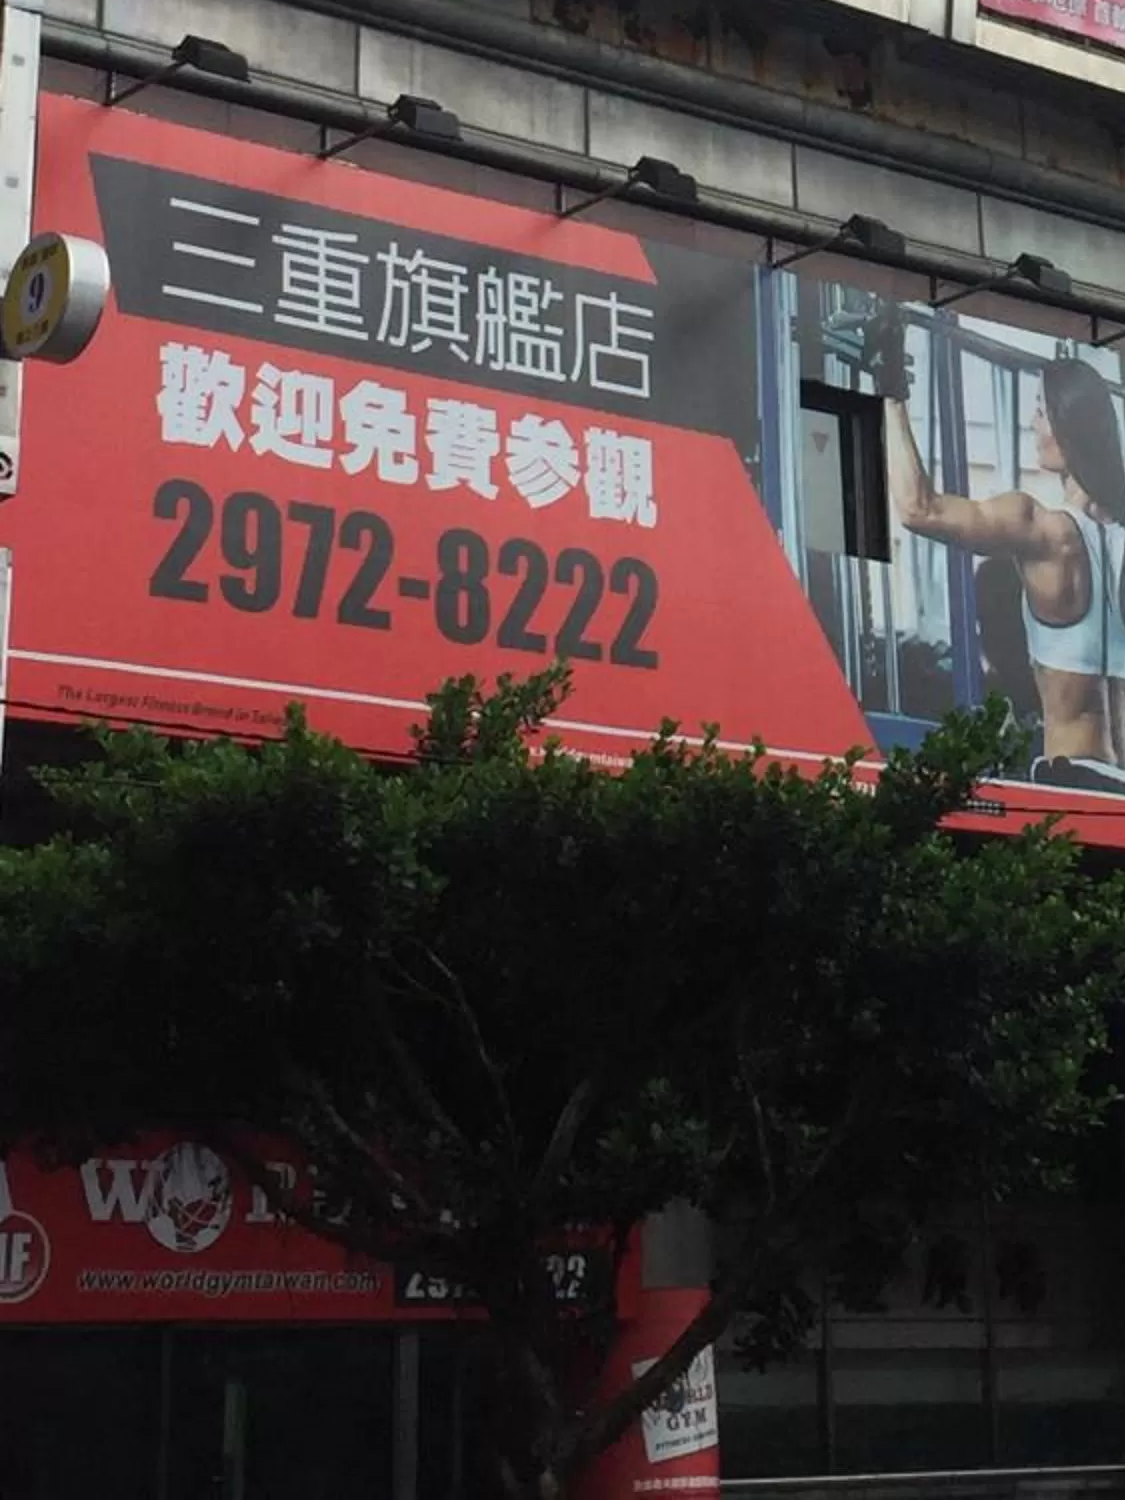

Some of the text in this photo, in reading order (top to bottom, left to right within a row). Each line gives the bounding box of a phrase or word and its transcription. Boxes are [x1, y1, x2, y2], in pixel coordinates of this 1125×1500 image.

[29, 272, 45, 314] 9
[162, 196, 656, 399] 三重旗艦店
[150, 478, 660, 671] 2972-8222
